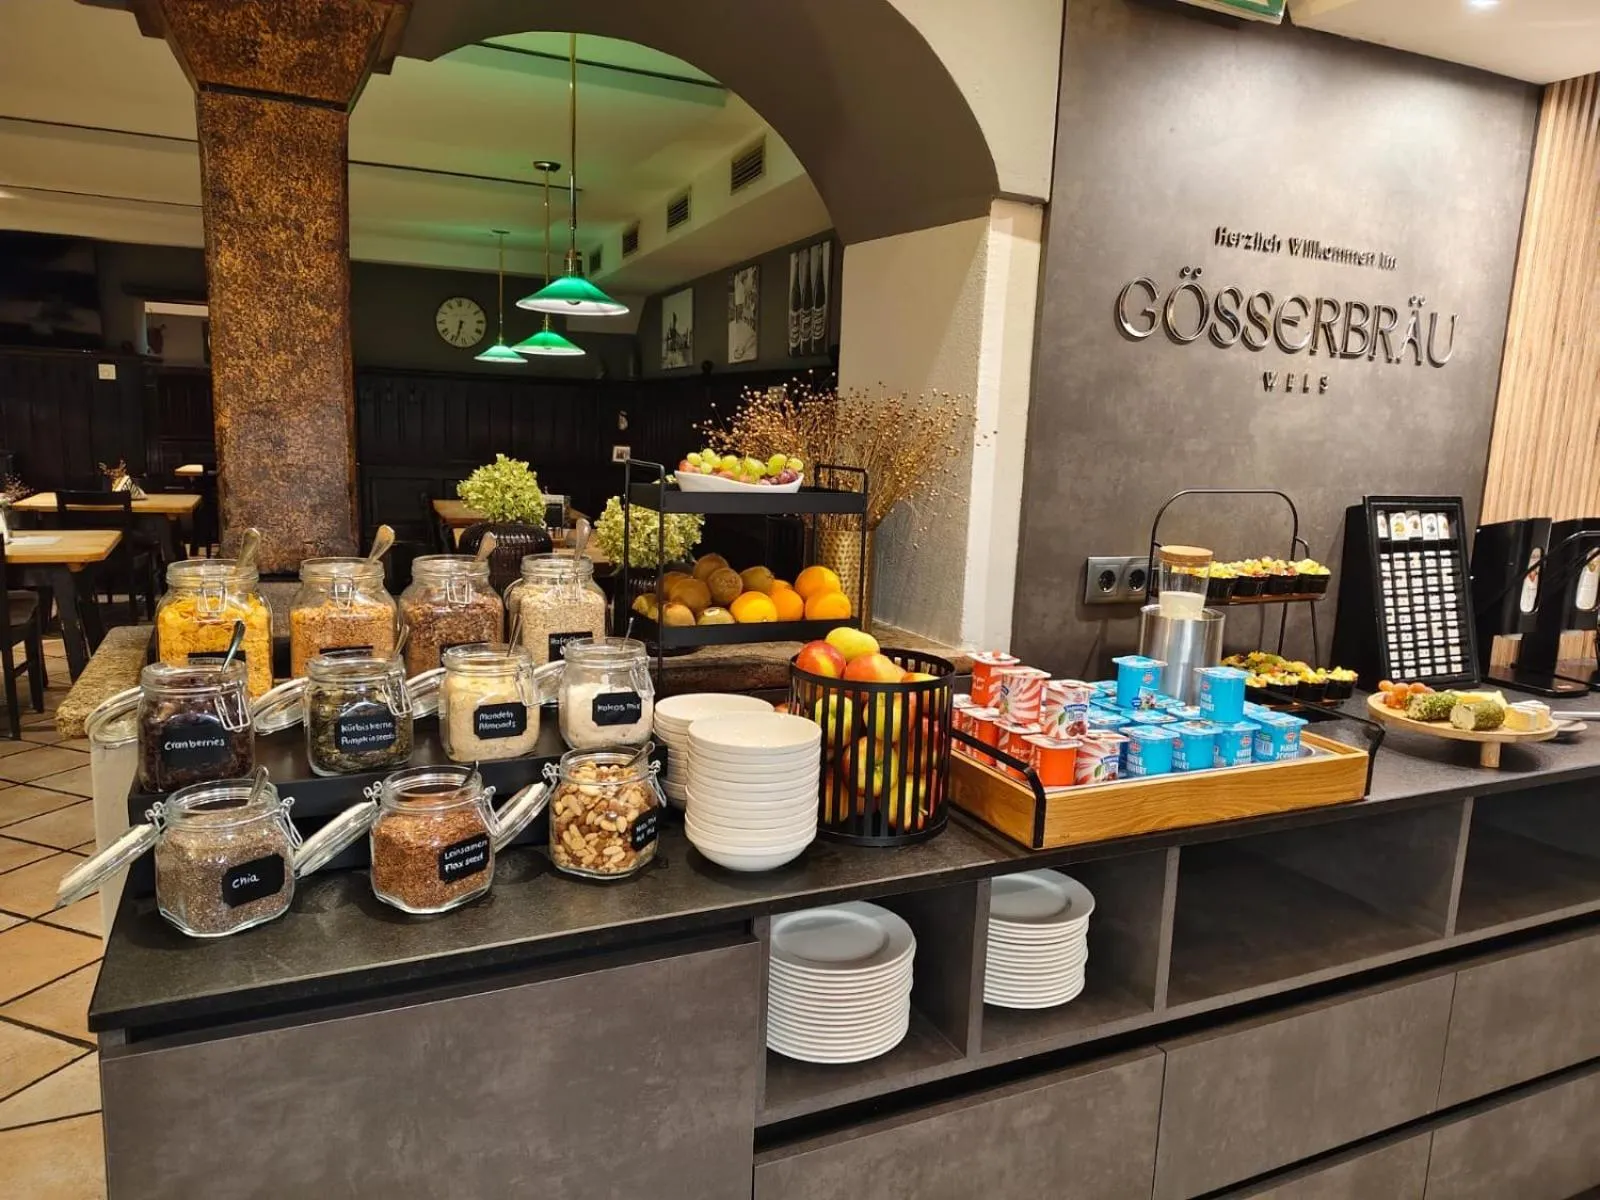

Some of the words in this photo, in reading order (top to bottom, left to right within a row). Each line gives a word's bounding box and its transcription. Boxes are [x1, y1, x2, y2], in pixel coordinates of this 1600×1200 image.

[1214, 226, 1281, 253] Herzlich
[1288, 237, 1376, 267] Willkommen
[1114, 265, 1459, 368] GÖSSERBRÄU
[1262, 371, 1329, 394] WELS
[164, 736, 225, 751] Cranberries
